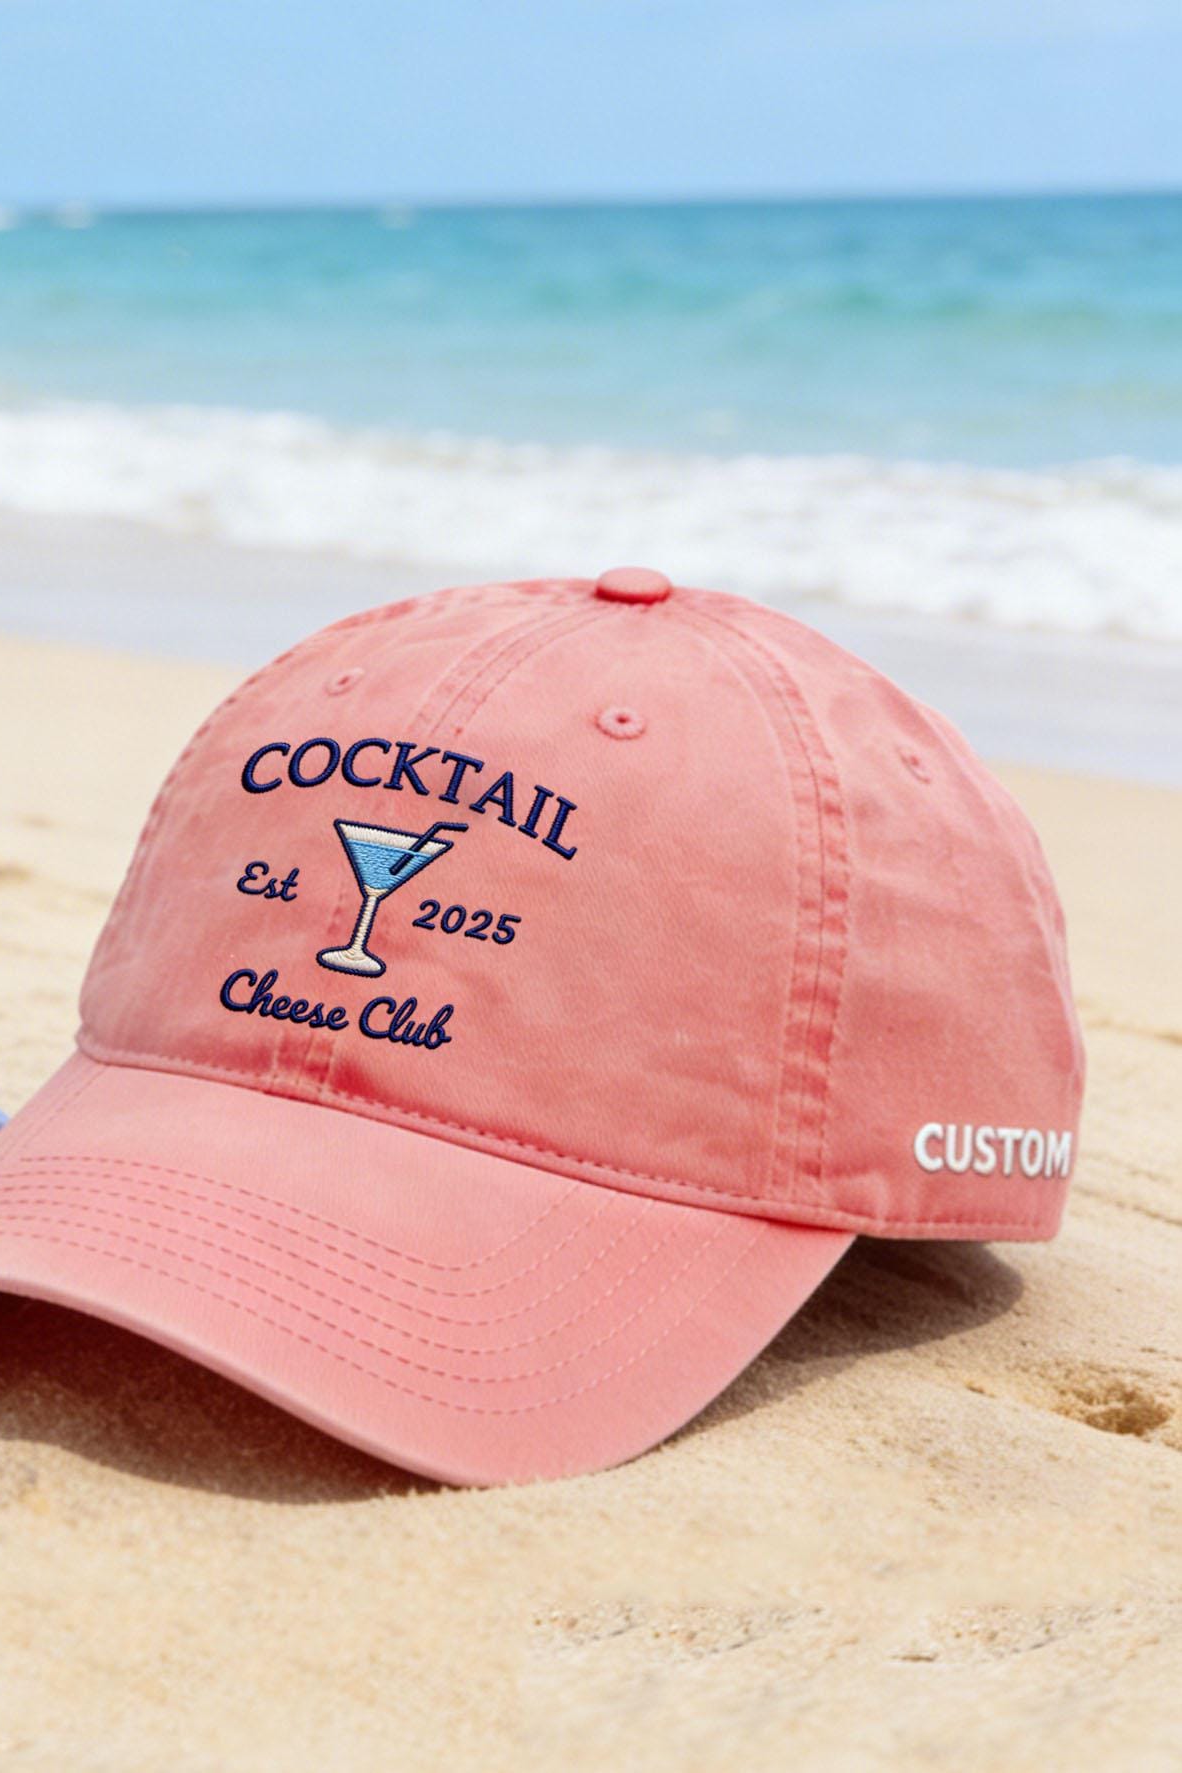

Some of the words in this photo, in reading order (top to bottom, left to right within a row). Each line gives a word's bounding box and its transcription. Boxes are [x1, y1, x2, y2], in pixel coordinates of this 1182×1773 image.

[242, 738, 577, 860] COCKTAIL
[237, 861, 300, 901] Est
[413, 899, 522, 945] 2025
[220, 969, 350, 1031] Cheese
[359, 996, 454, 1049] Club
[914, 1123, 1072, 1178] CUSTOM
